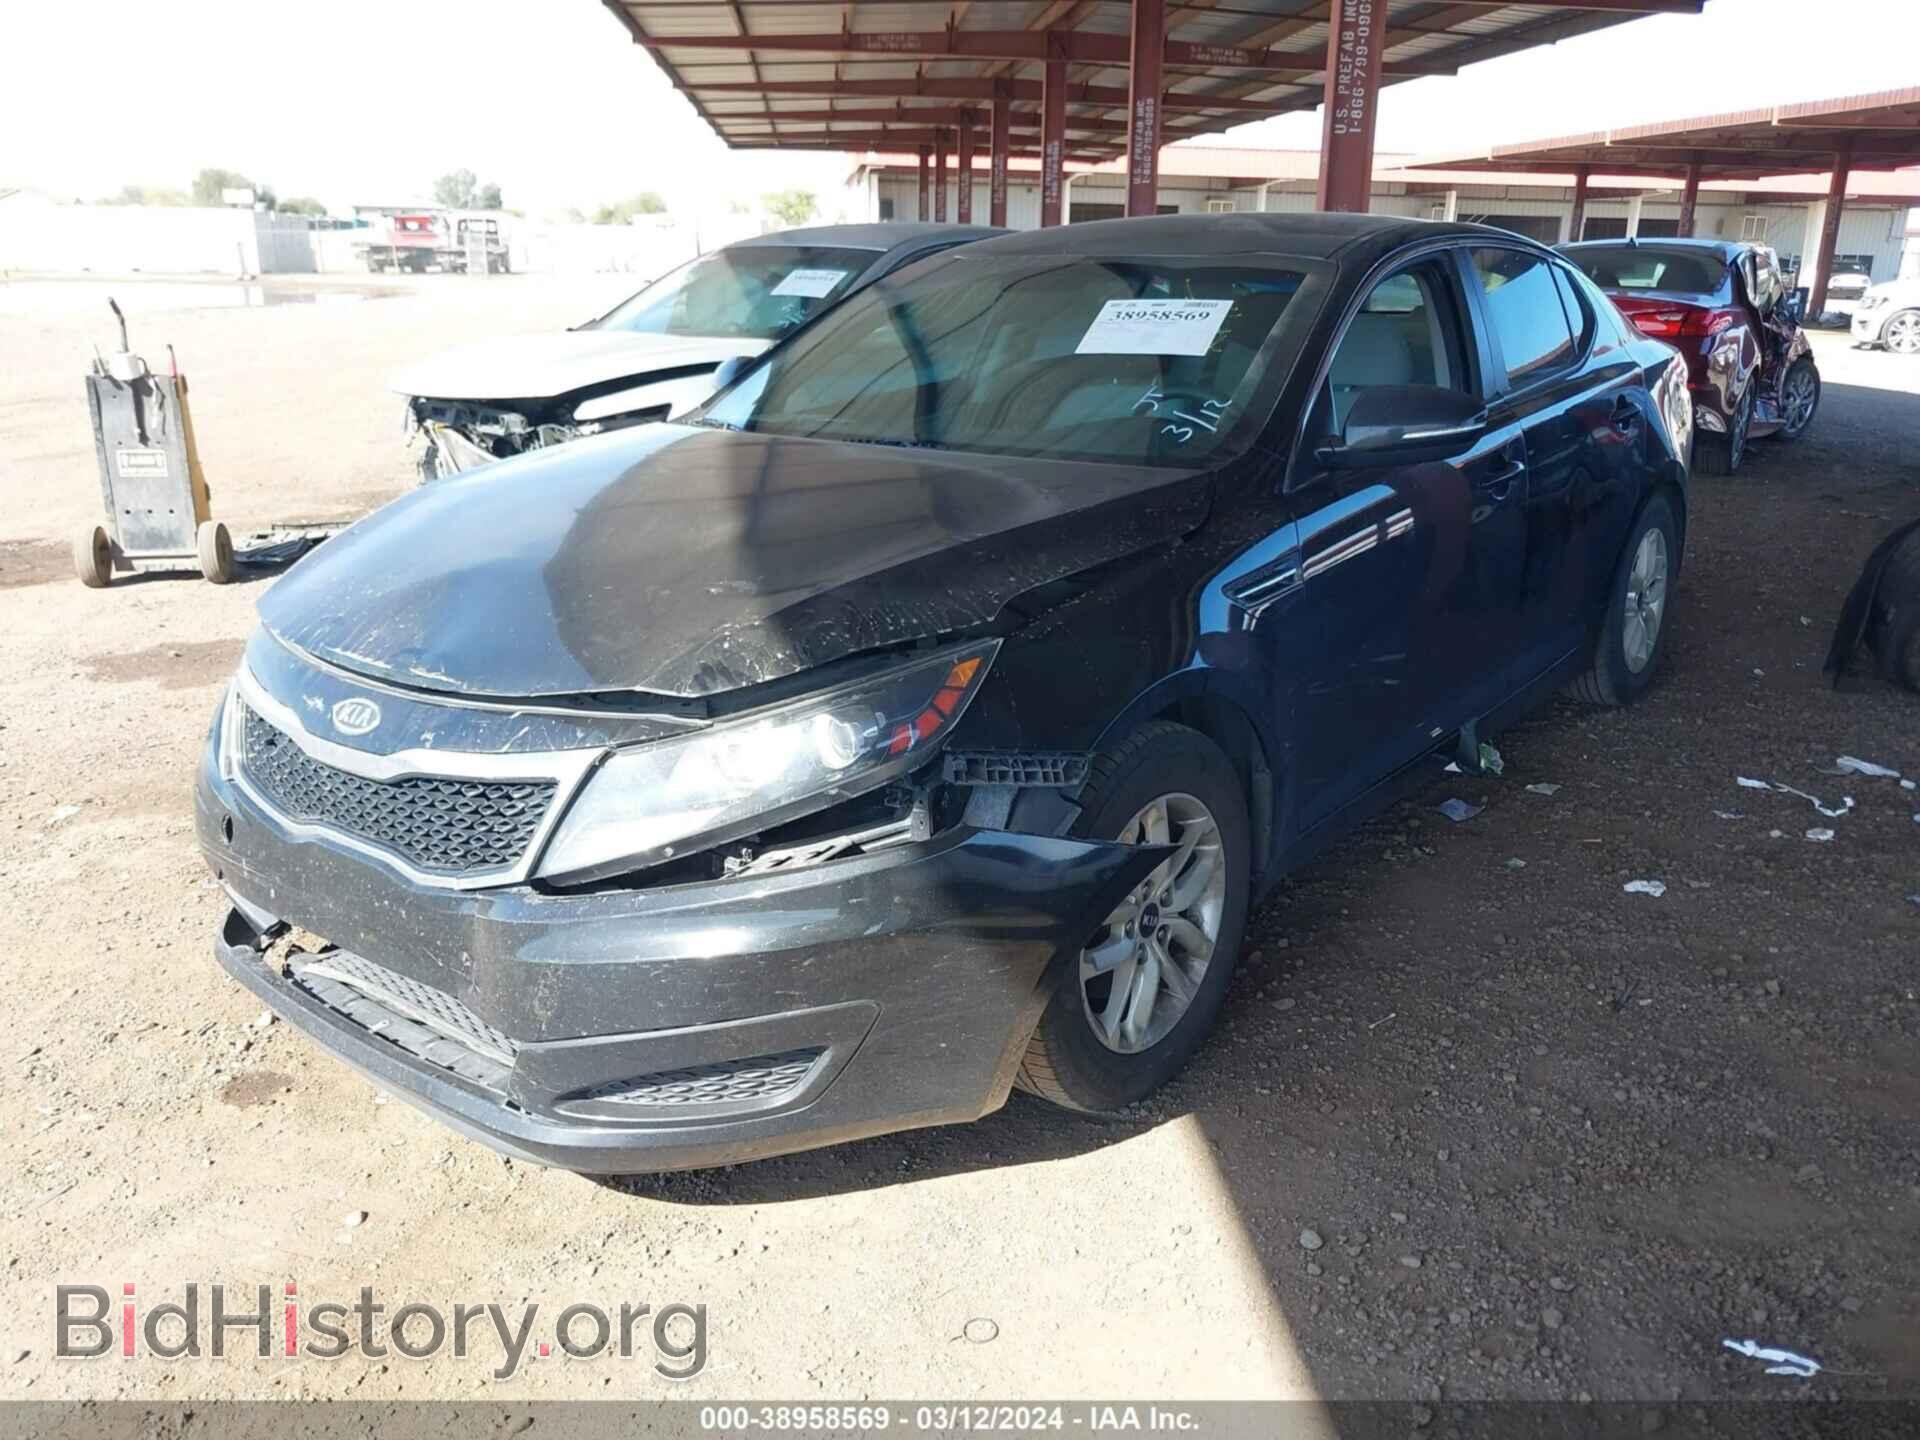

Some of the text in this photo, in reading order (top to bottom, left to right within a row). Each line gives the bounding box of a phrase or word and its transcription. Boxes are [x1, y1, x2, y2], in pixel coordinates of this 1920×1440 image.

[1338, 31, 1355, 94] PREFAB
[1349, 0, 1372, 133] 1-866-799-096
[1110, 310, 1211, 321] 38958569
[1161, 399, 1232, 442] 3/12
